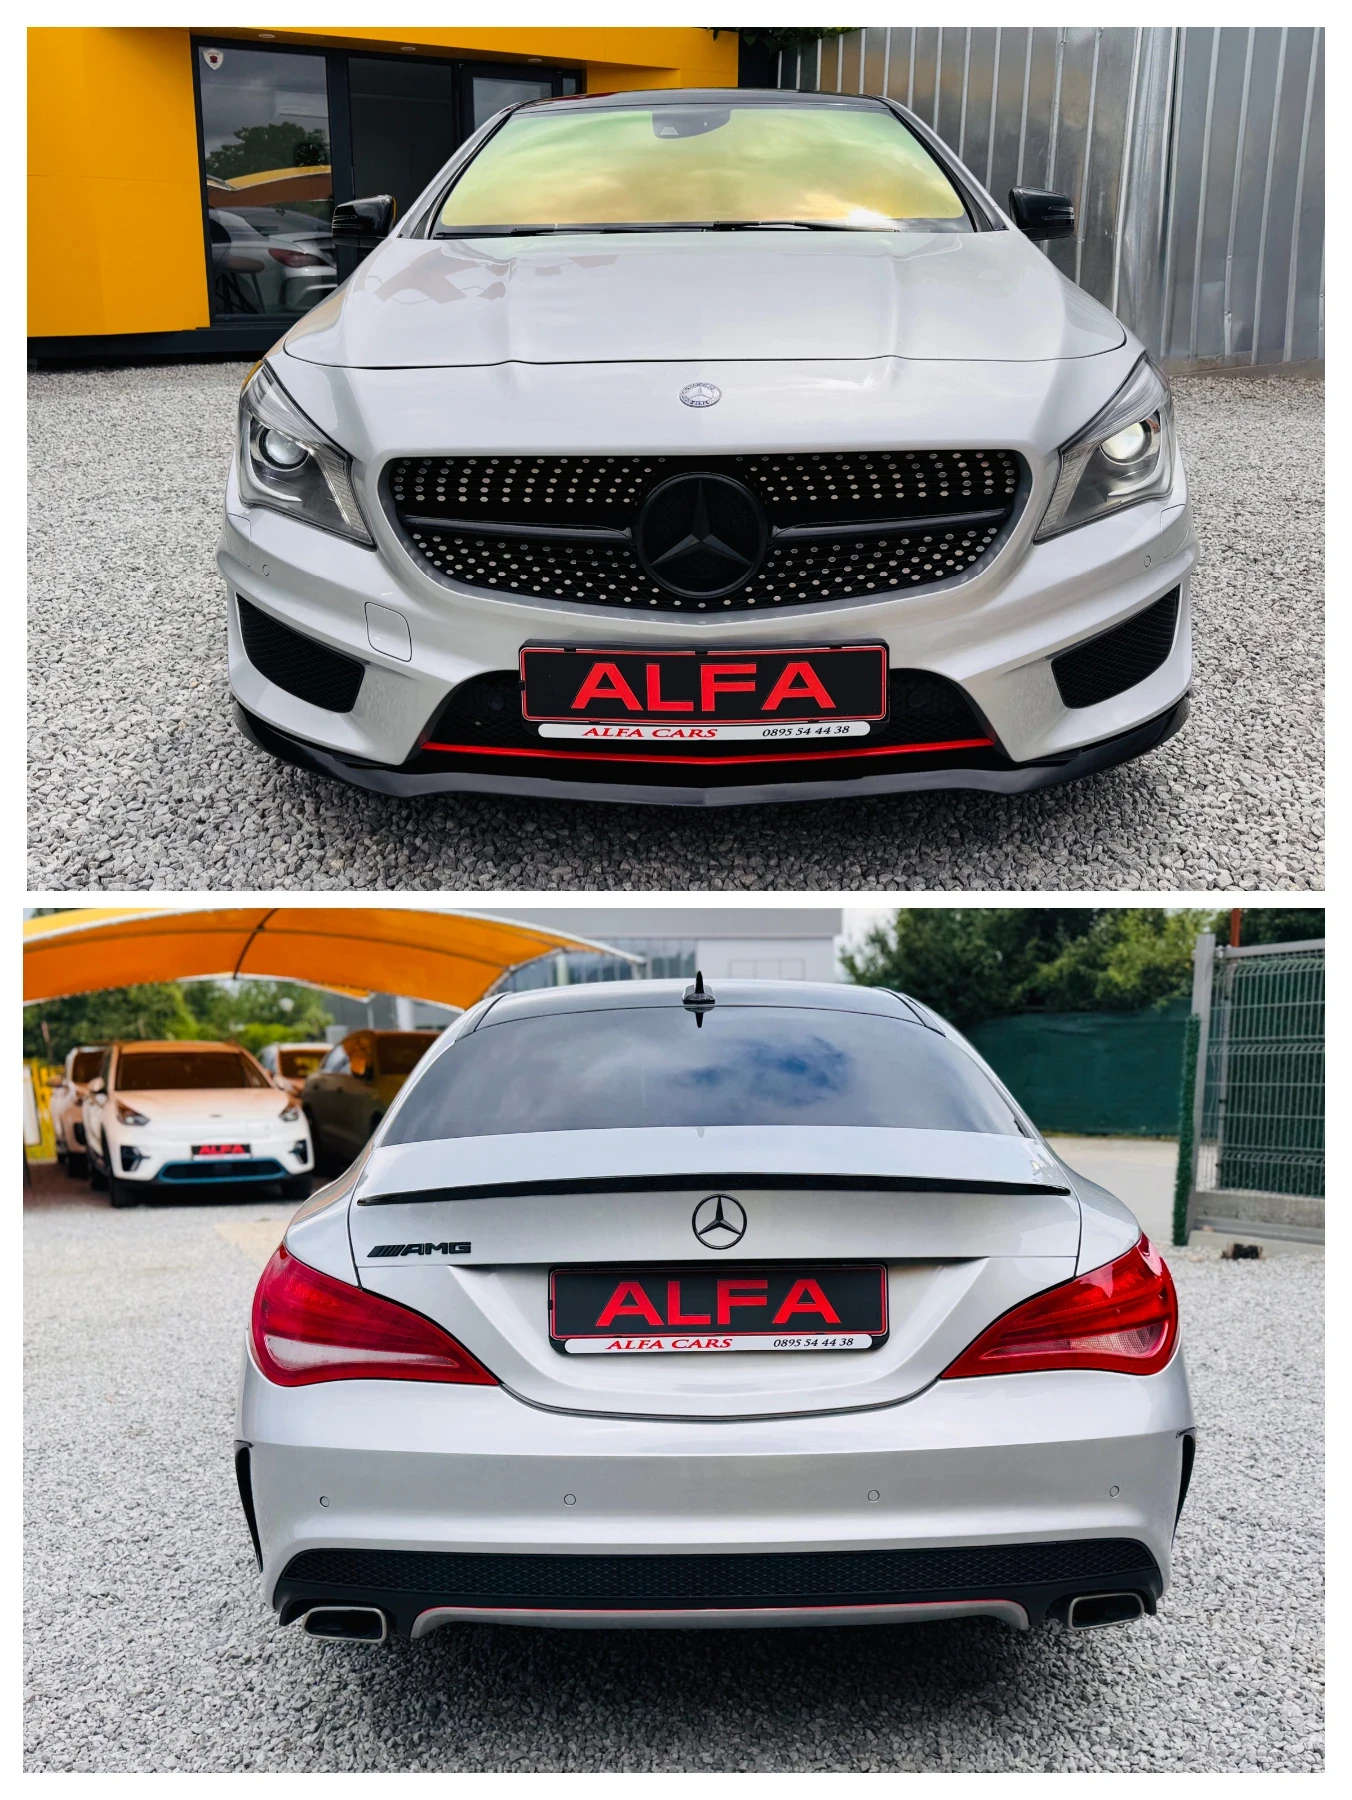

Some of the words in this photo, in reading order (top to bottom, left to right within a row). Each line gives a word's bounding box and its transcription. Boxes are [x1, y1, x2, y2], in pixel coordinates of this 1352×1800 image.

[570, 661, 837, 712] ALFA
[581, 727, 645, 738] ALFA
[651, 728, 718, 738] CARS
[762, 727, 793, 738] 0895
[795, 727, 811, 736] 54
[814, 726, 831, 735] 44
[833, 725, 850, 734] 38
[197, 1143, 246, 1156] ALFA
[595, 1279, 842, 1327] ALFA
[605, 1339, 665, 1350] ALFA
[671, 1338, 733, 1349] CARS
[773, 1338, 801, 1348] 0895
[803, 1338, 818, 1347] 54
[821, 1338, 837, 1347] 44
[838, 1337, 854, 1347] 38
